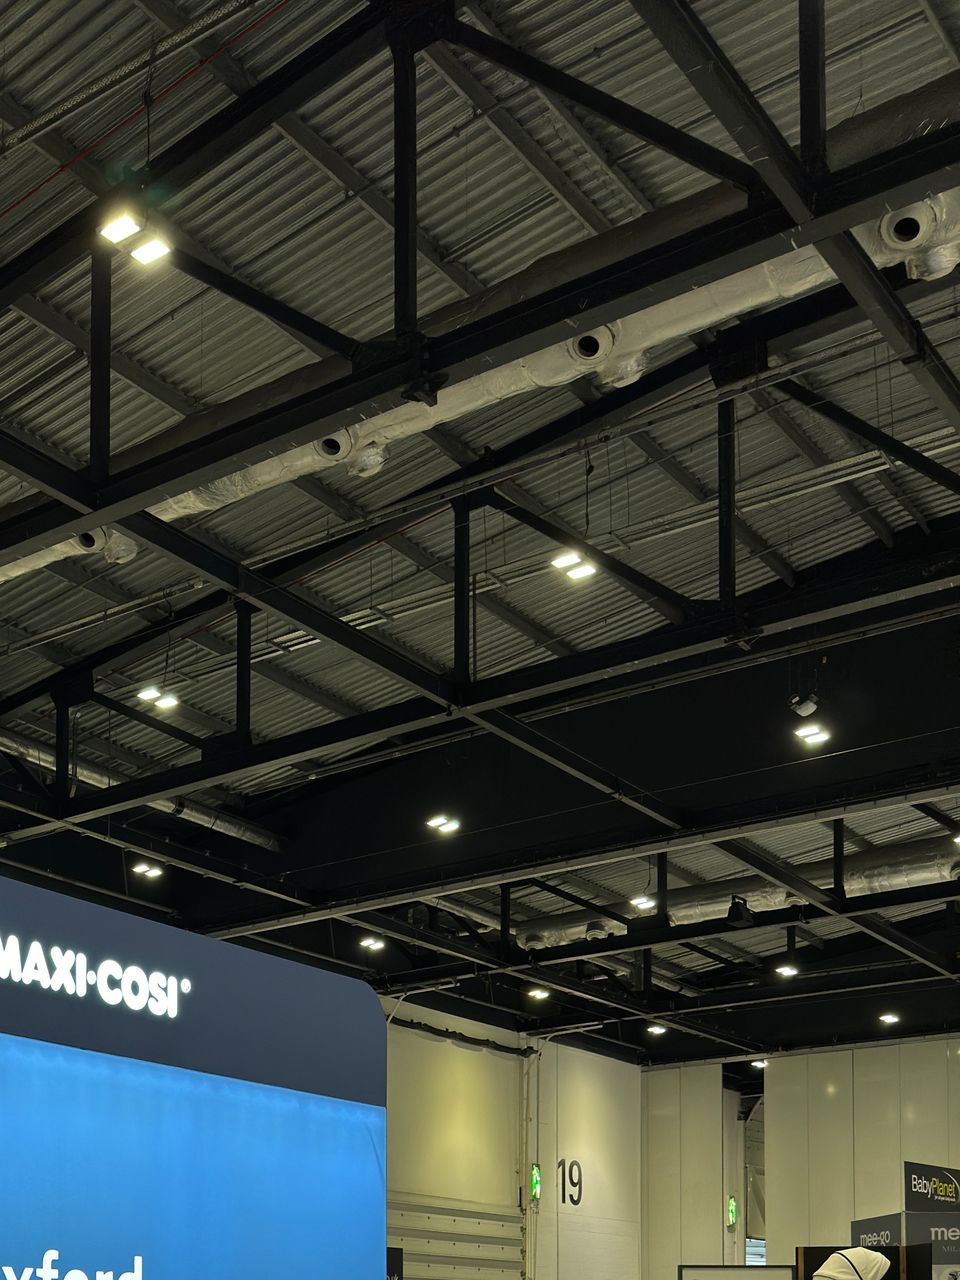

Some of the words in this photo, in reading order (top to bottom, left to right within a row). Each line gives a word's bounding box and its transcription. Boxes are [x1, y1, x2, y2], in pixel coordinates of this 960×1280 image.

[557, 1158, 583, 1206] 19
[911, 1174, 956, 1198] BabyPlanet
[860, 1231, 891, 1247] mee-go
